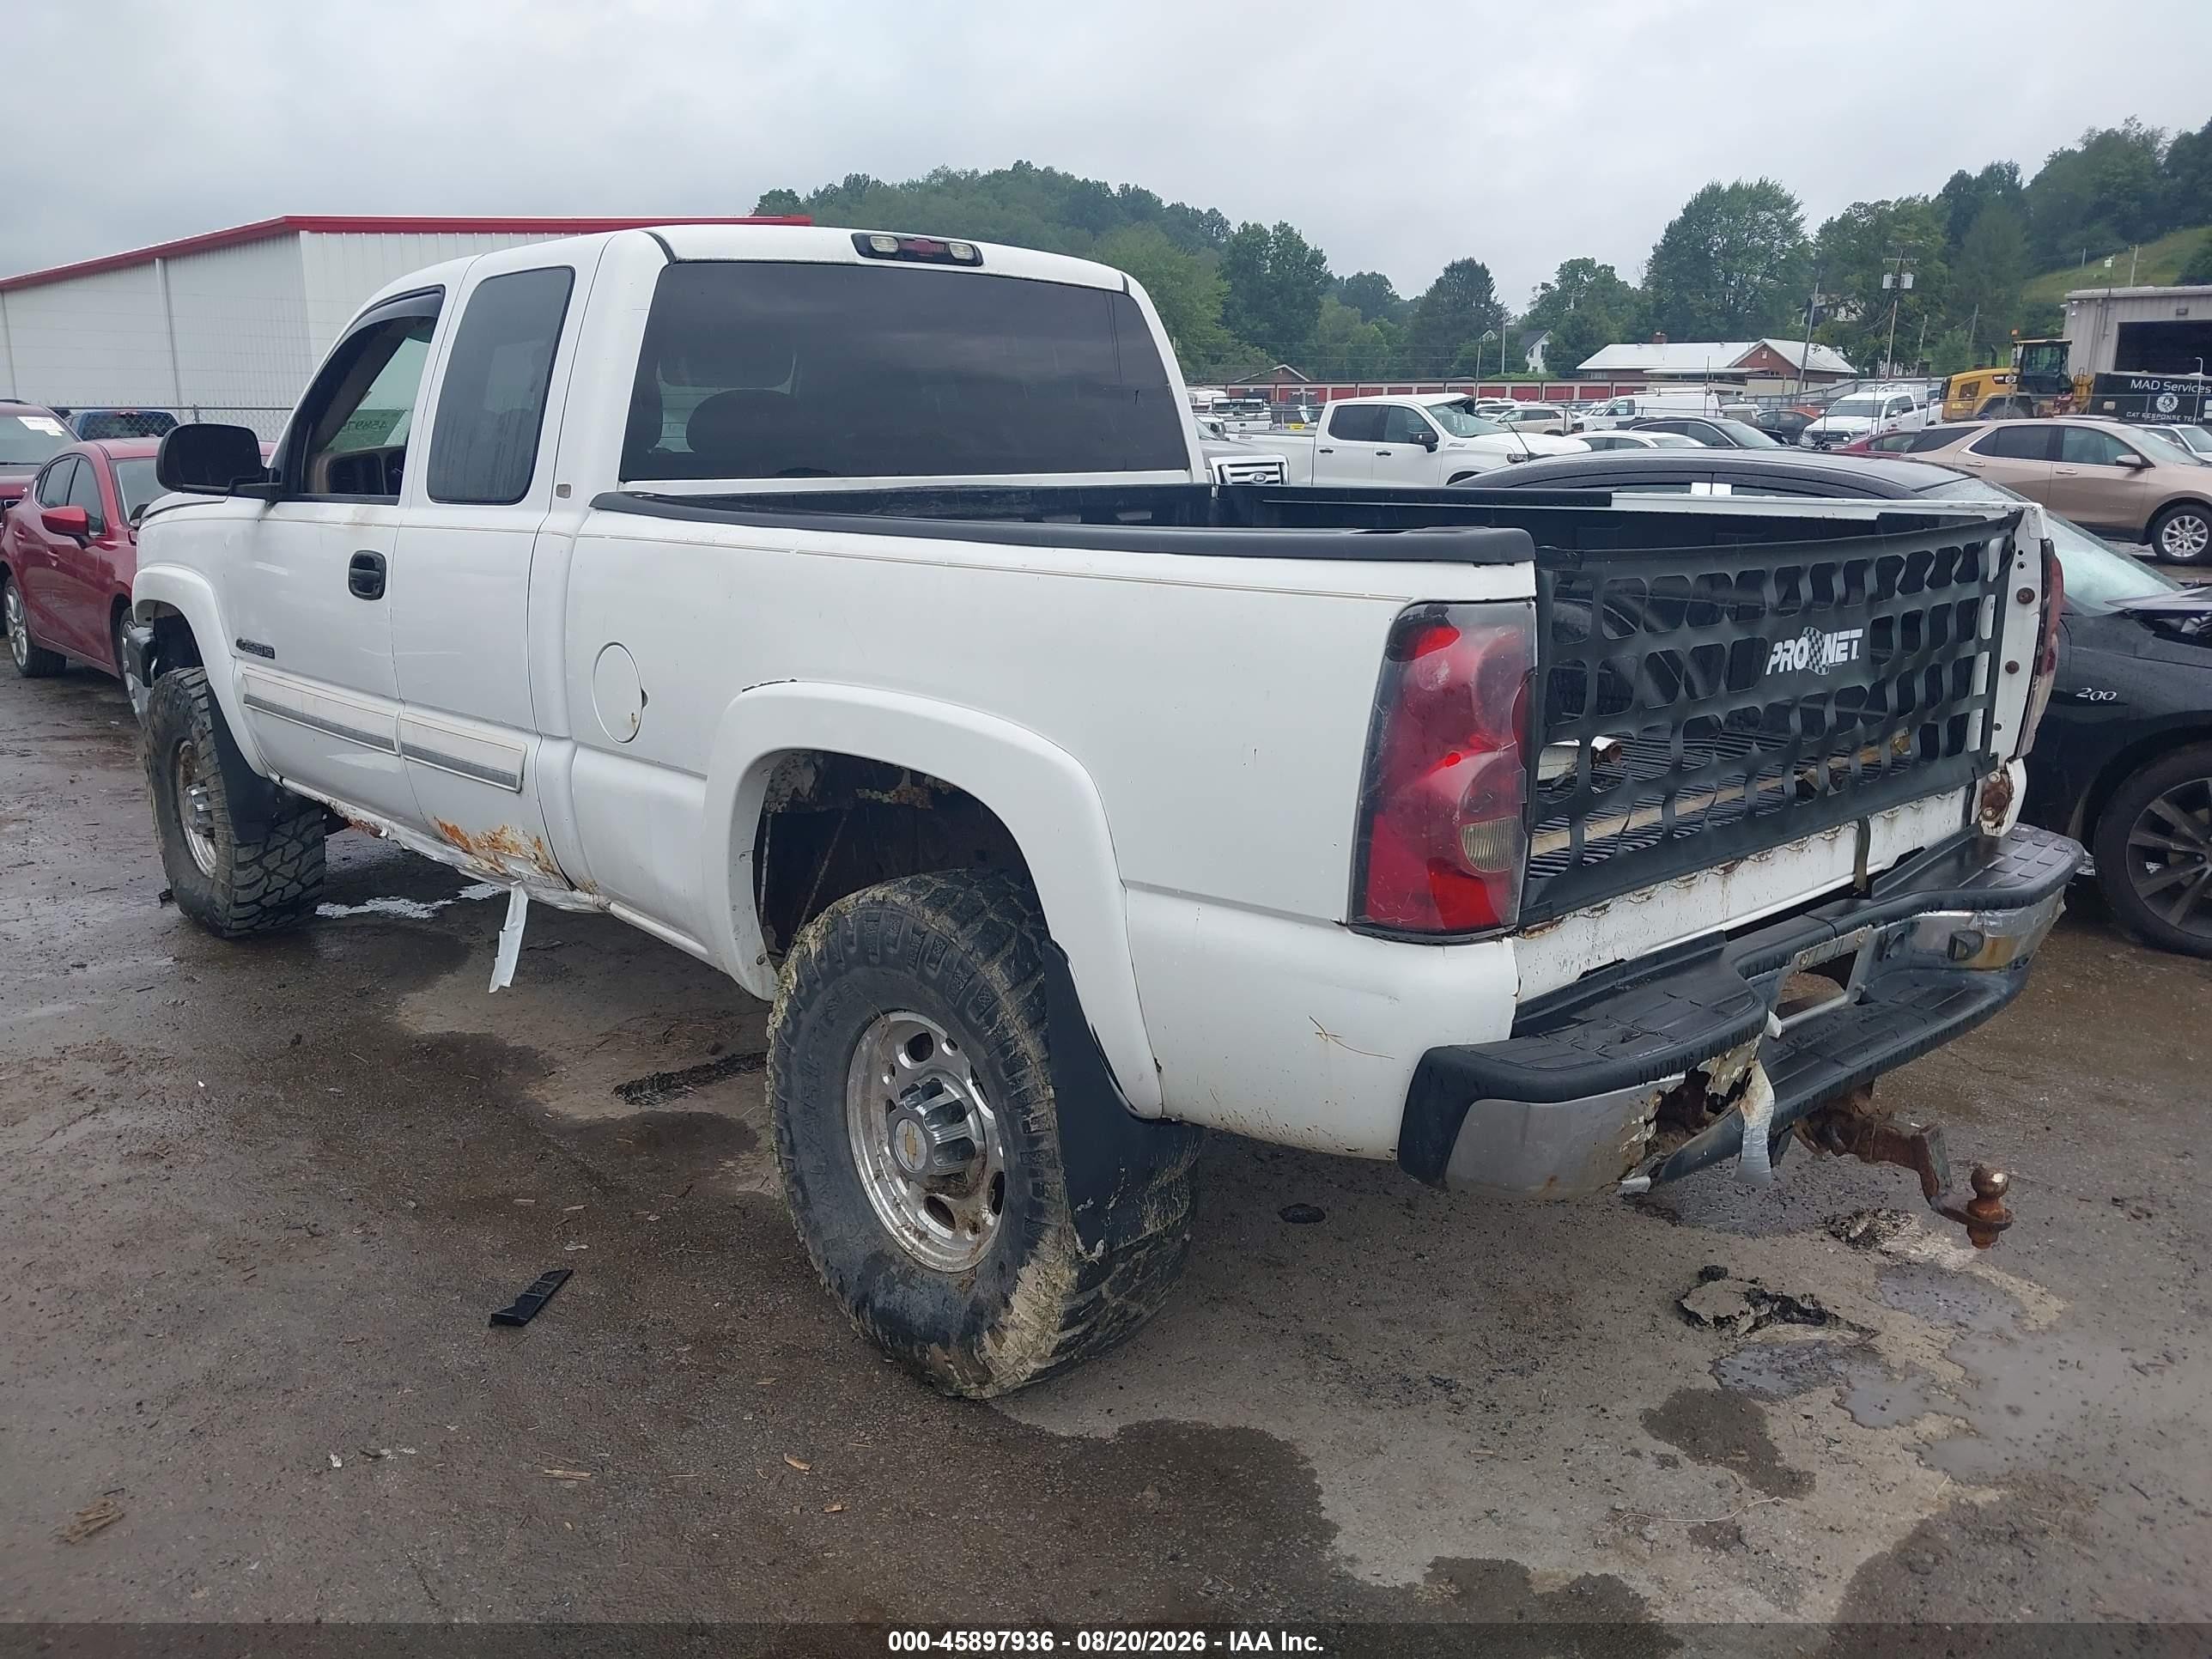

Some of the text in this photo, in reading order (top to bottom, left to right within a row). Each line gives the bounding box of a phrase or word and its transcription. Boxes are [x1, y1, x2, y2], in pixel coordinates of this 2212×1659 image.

[2130, 379, 2212, 393] MAD Services
[1765, 636, 1809, 676] PRO
[2075, 687, 2118, 701] 200
